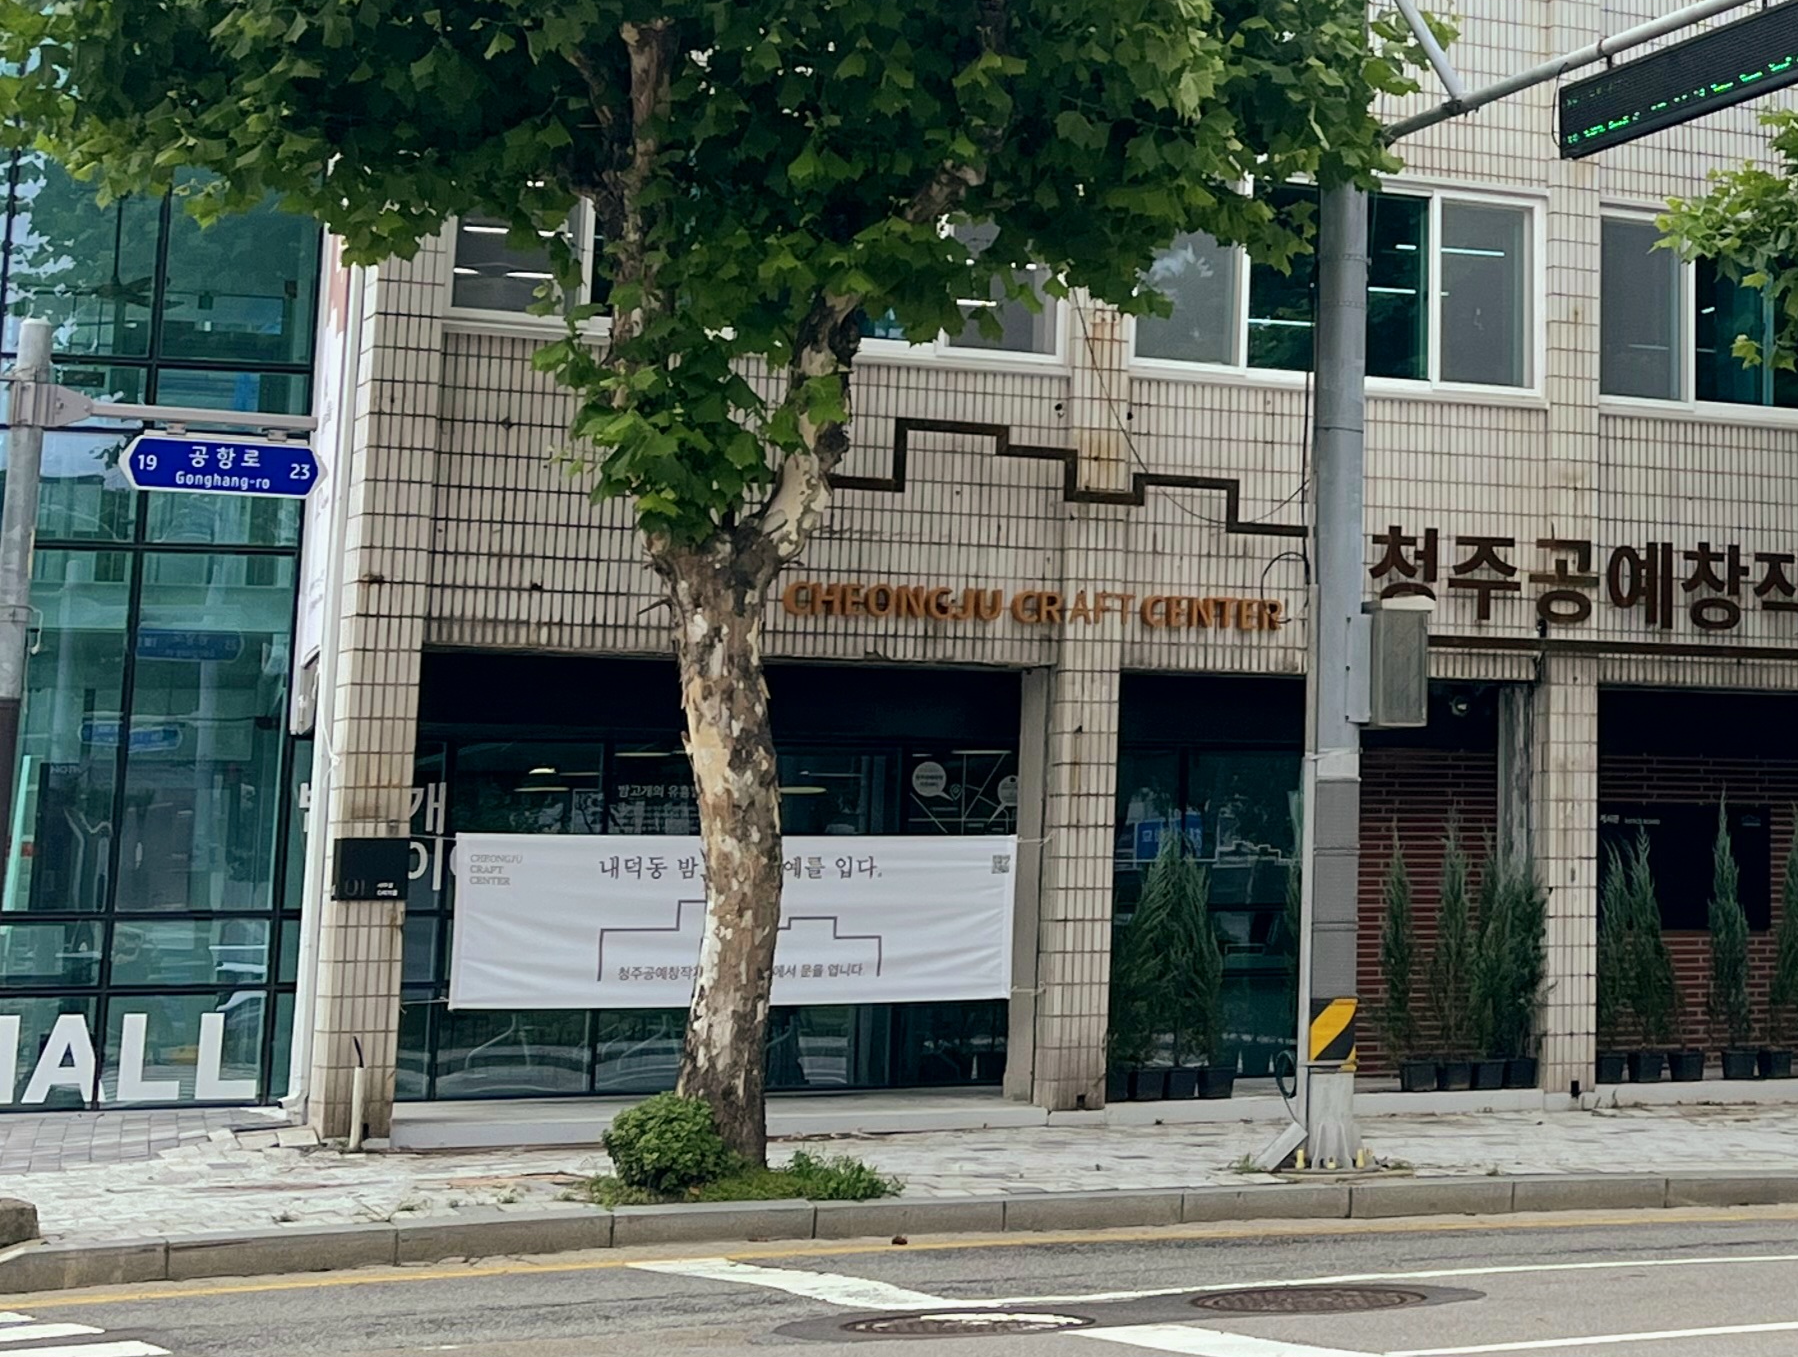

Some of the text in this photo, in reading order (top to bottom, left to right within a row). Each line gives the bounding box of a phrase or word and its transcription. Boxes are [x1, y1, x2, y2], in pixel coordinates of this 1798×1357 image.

[137, 454, 158, 471] 19
[188, 446, 261, 470] 공항로
[175, 471, 271, 491] Gonghang-ro
[289, 463, 311, 480] 23
[782, 581, 1284, 631] CHEONGJU CRAFT CENTER
[599, 856, 668, 880] 내덕동
[469, 876, 511, 885] CENTER
